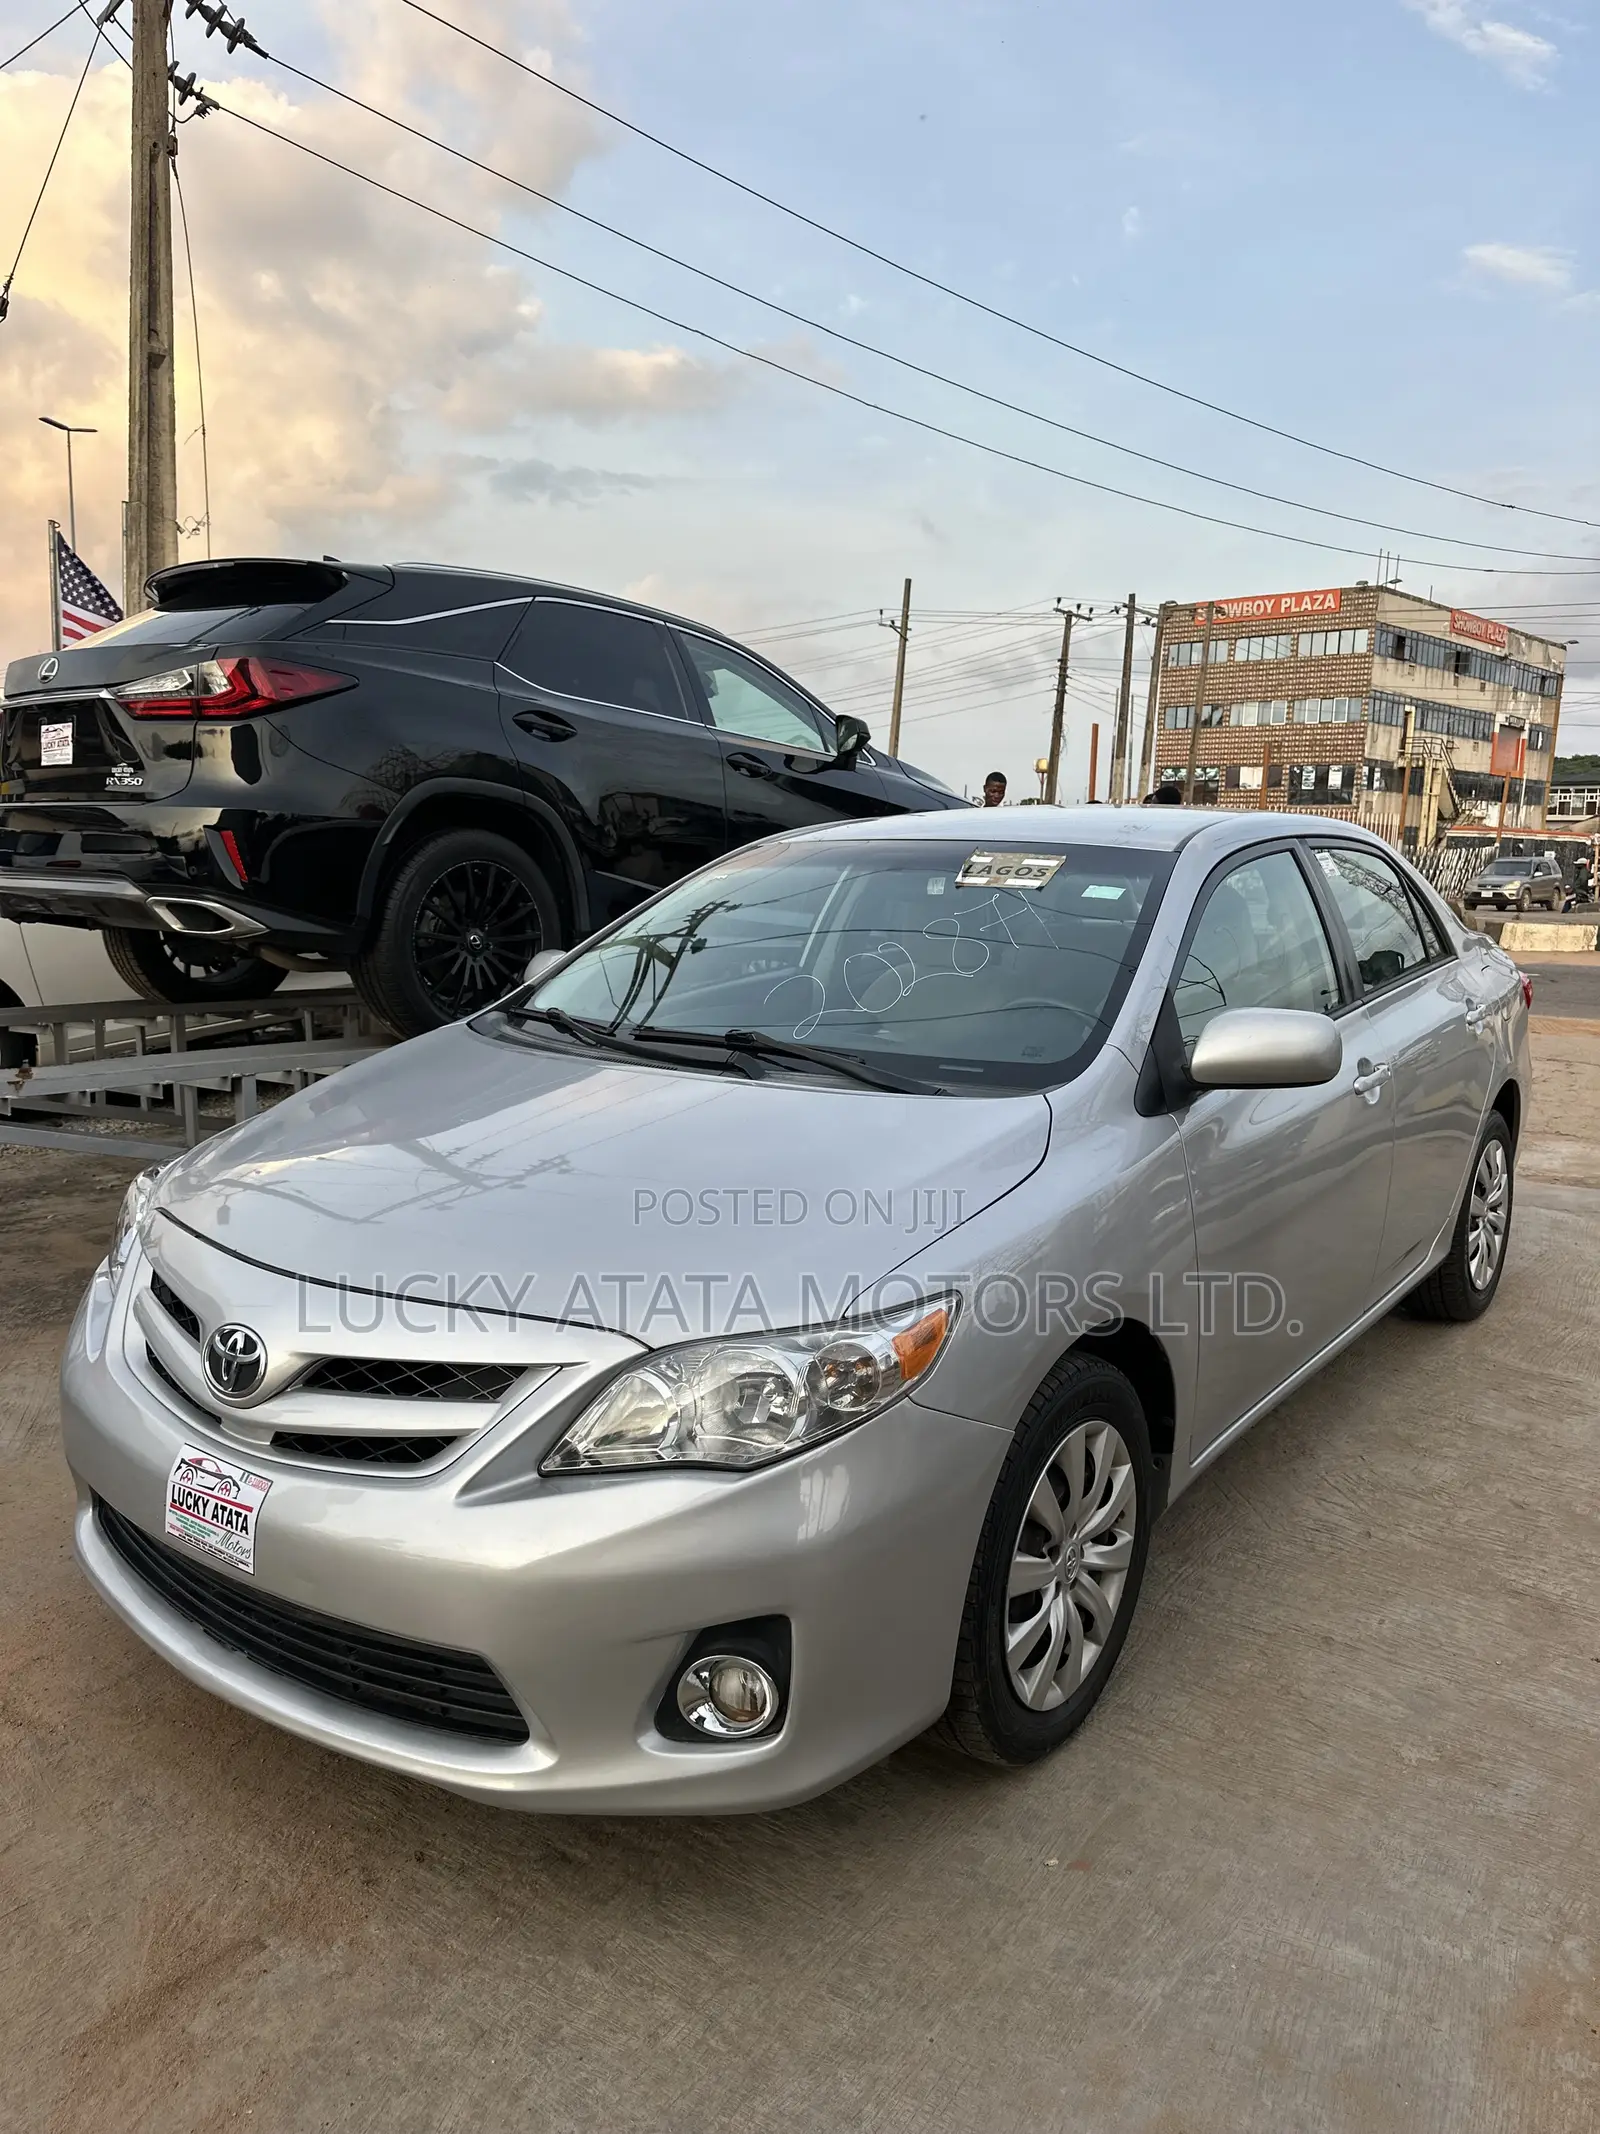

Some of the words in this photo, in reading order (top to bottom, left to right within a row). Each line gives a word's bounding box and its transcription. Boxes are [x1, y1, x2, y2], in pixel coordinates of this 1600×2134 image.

[1280, 593, 1336, 613] PLAZA
[962, 864, 1049, 877] LAGOS
[171, 1484, 209, 1518] LUCKY
[211, 1502, 249, 1536] ATATA
[215, 1530, 252, 1559] Motors
